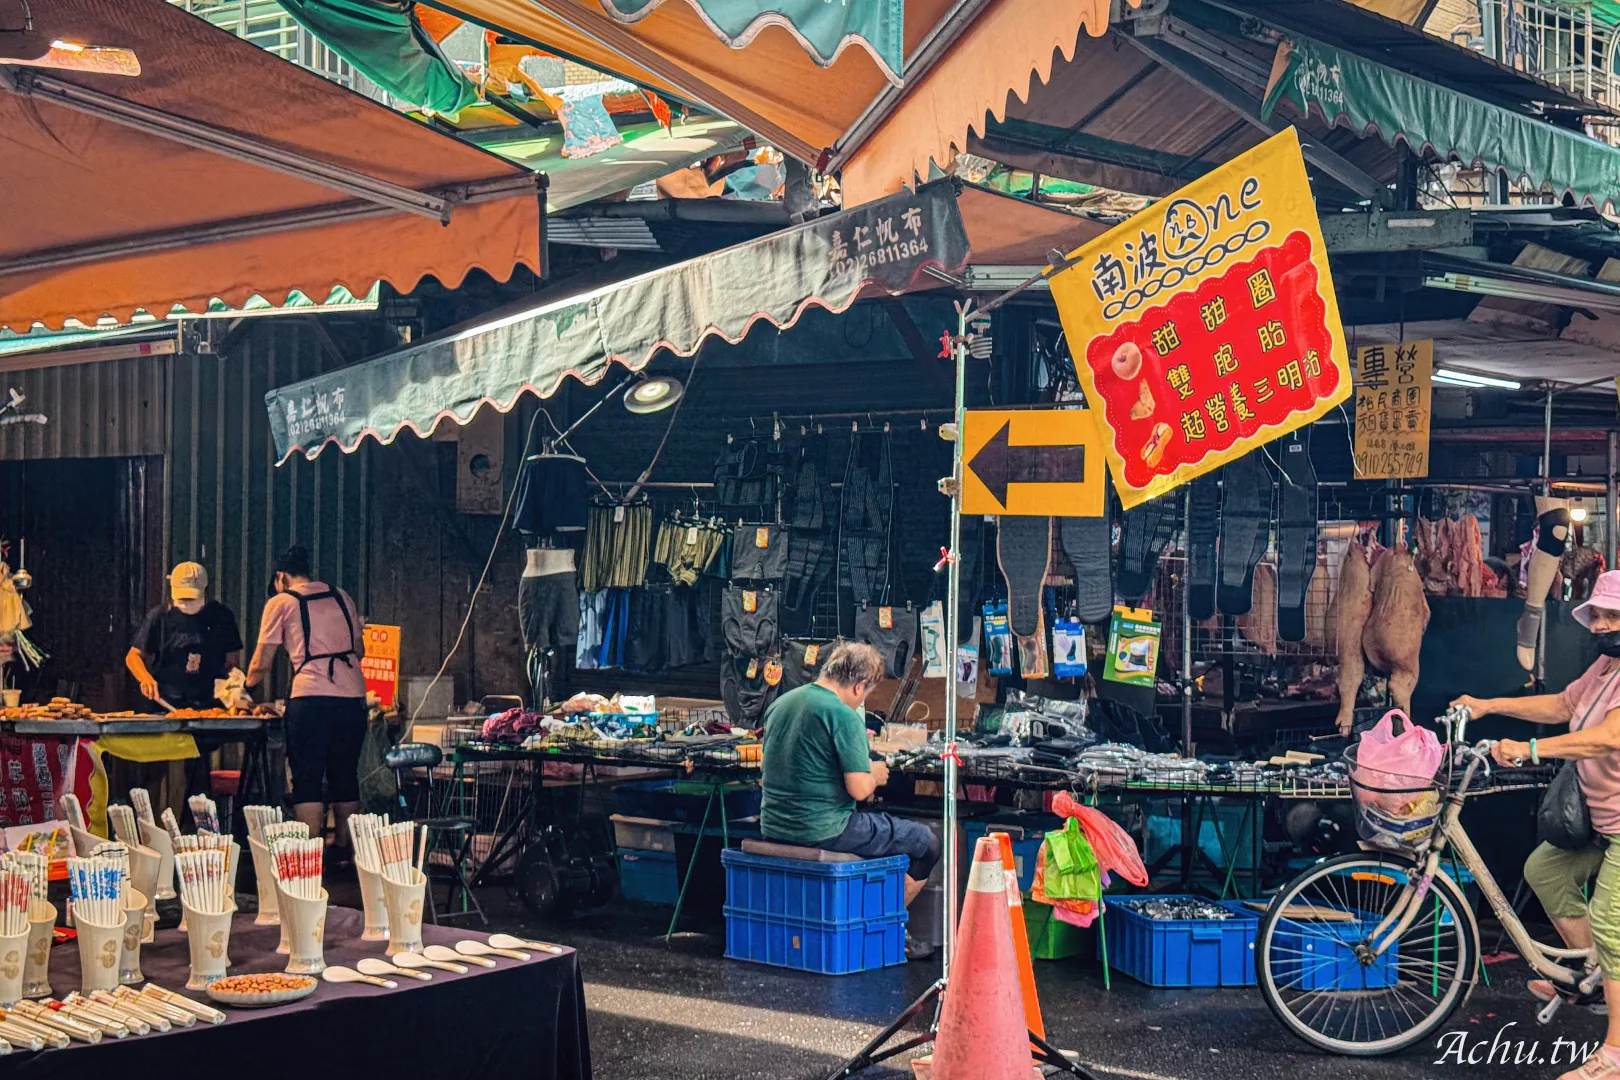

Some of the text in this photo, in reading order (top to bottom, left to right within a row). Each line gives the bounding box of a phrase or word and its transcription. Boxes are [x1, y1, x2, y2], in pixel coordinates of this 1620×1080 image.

[829, 207, 922, 261] 嘉仁帆布
[1151, 267, 1276, 357] 甜甜圈
[1165, 319, 1286, 401] 雙胞胎
[1179, 348, 1322, 444] 超營養三明治
[1361, 344, 1418, 390] 專營
